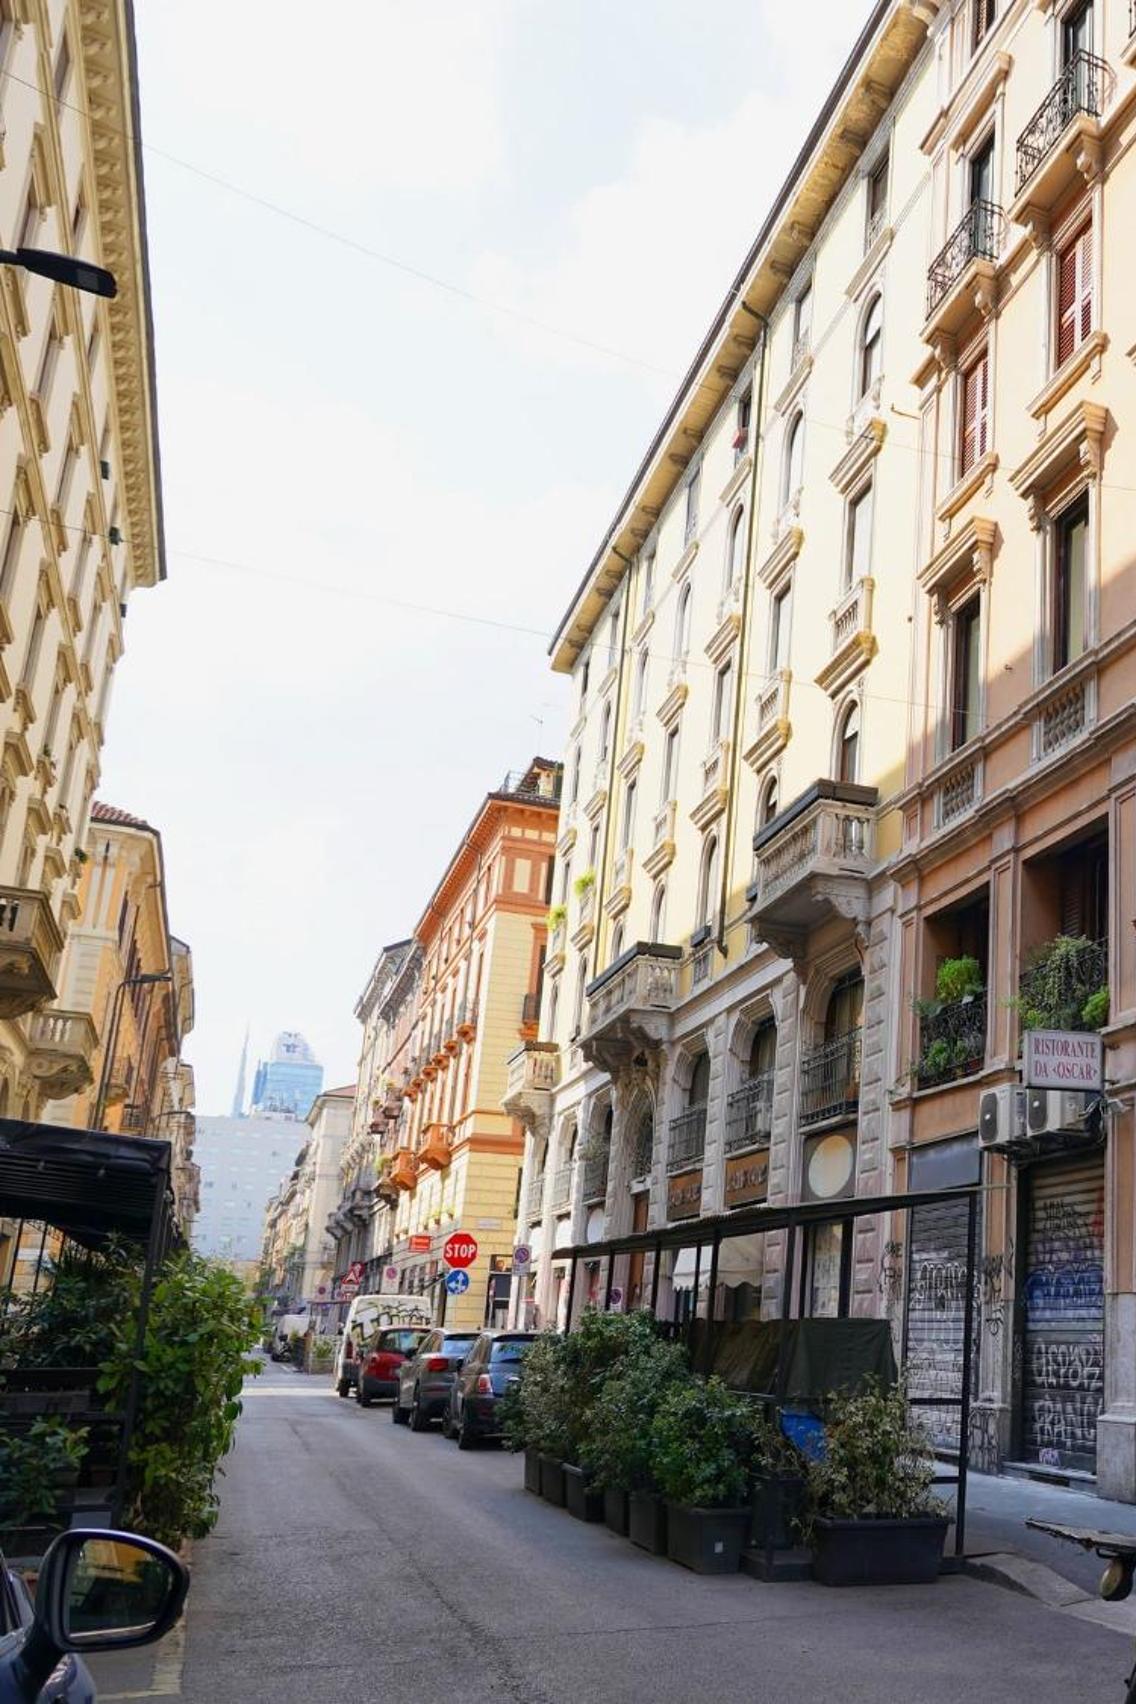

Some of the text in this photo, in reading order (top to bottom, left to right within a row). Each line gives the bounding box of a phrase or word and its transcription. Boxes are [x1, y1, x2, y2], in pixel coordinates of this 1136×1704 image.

[1033, 1037, 1098, 1059] RISTORANTE
[1034, 1060, 1049, 1078] DA
[445, 1245, 477, 1258] STOP
